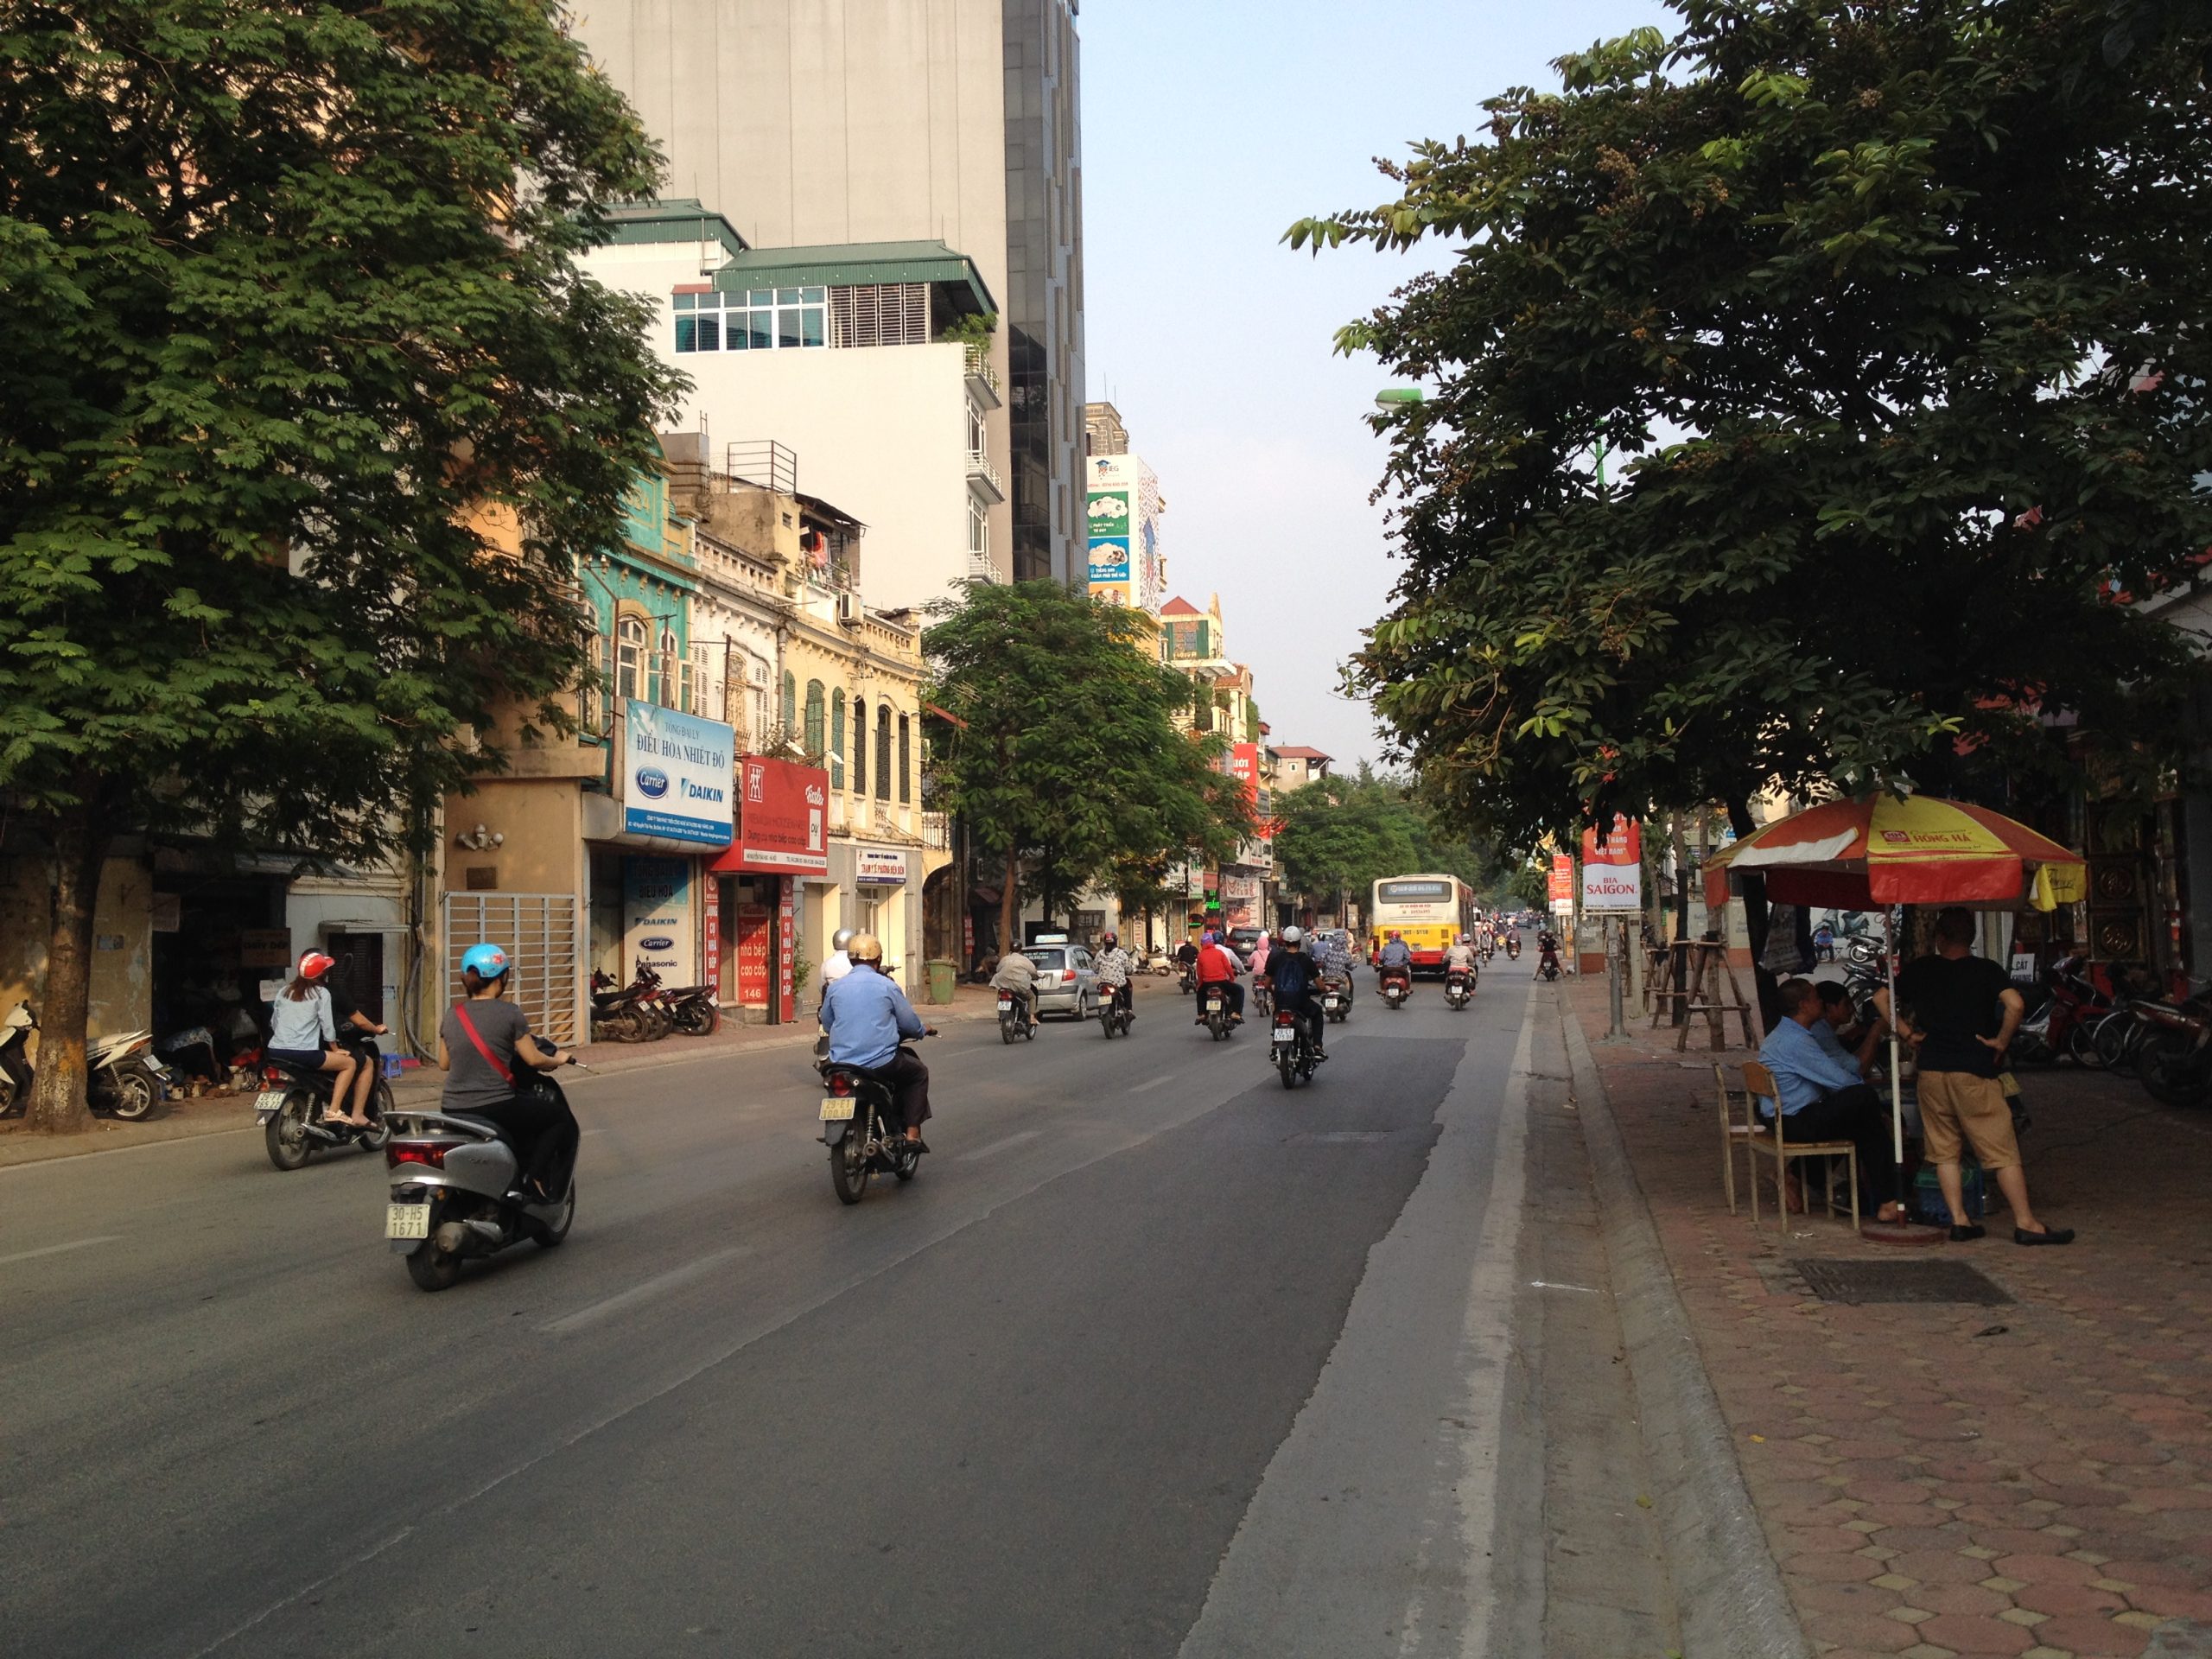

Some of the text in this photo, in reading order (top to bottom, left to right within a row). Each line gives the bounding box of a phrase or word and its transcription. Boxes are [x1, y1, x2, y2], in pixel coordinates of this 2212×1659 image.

[637, 729, 725, 772] ĐIỀU HÒA NHIỆT ĐỘ
[639, 772, 724, 803] Carrier DAIKIN
[1586, 884, 1635, 894] SAIGON
[741, 942, 766, 958] nhà bếp
[636, 959, 677, 969] Panasonic
[741, 961, 766, 978] cao cấp
[744, 988, 761, 998] 146
[392, 1207, 423, 1220] 30-H5
[392, 1222, 422, 1236] 1671
